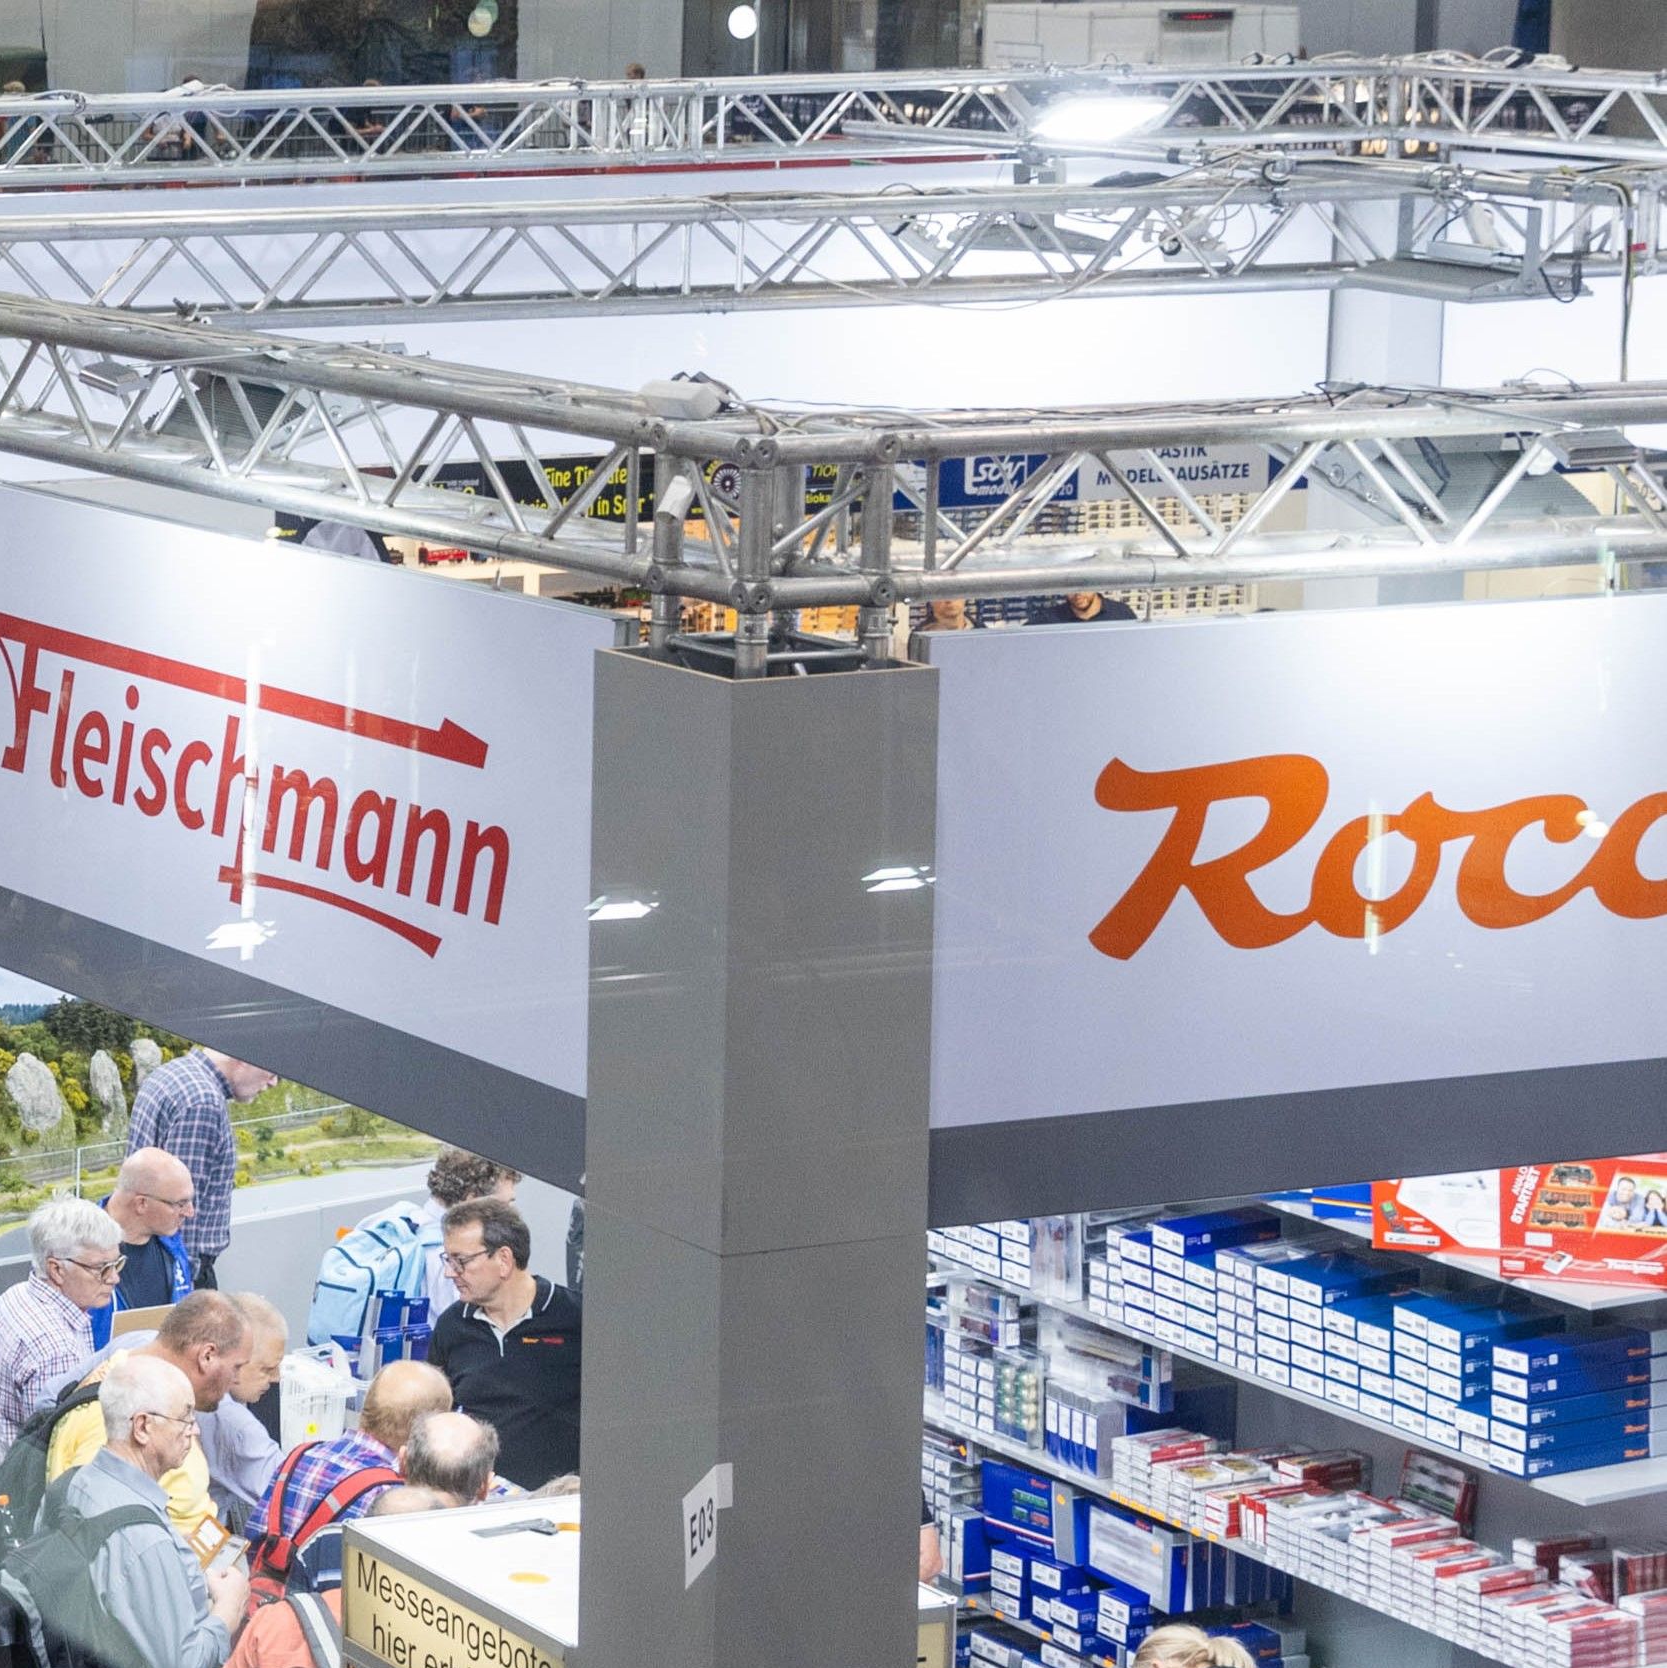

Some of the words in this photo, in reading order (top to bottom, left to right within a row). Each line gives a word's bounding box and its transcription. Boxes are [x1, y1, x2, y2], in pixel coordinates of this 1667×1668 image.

[0, 640, 510, 926] Fleischmann
[1088, 753, 1667, 961] Roco
[690, 1497, 715, 1558] E03
